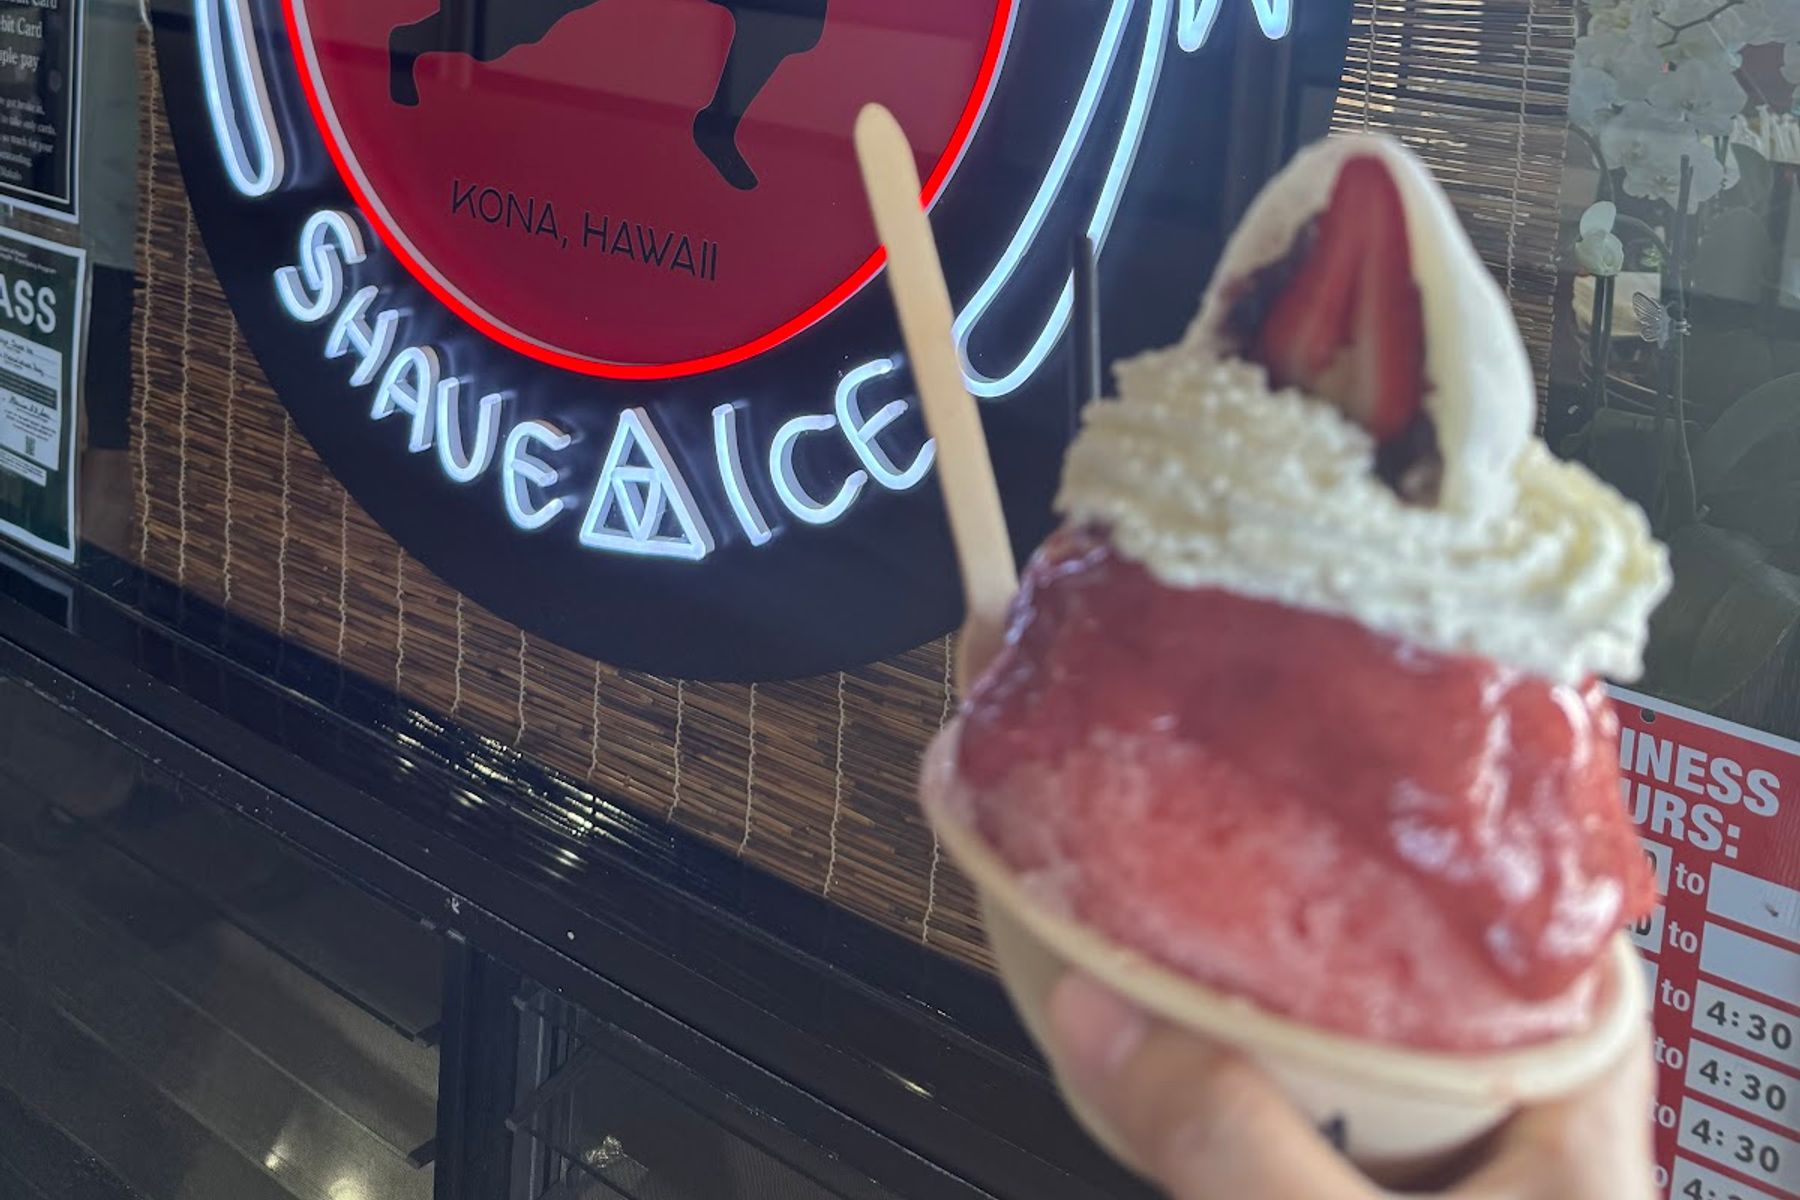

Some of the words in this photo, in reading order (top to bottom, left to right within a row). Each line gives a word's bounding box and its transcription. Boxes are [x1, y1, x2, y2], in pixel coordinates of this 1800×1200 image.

[0, 15, 15, 34] bit
[17, 17, 42, 39] Card
[21, 53, 39, 72] pay
[452, 180, 568, 248] KONA,
[583, 211, 718, 281] HAWAII
[712, 358, 936, 546] ICE
[1620, 777, 1741, 859] URS:
[1675, 863, 1706, 895] to
[1668, 920, 1698, 954] to
[1661, 978, 1691, 1012] to
[1707, 1000, 1793, 1051] 4:30
[1654, 1036, 1684, 1070] to
[1699, 1059, 1787, 1112] 4:30
[1691, 1118, 1781, 1173] 4:30
